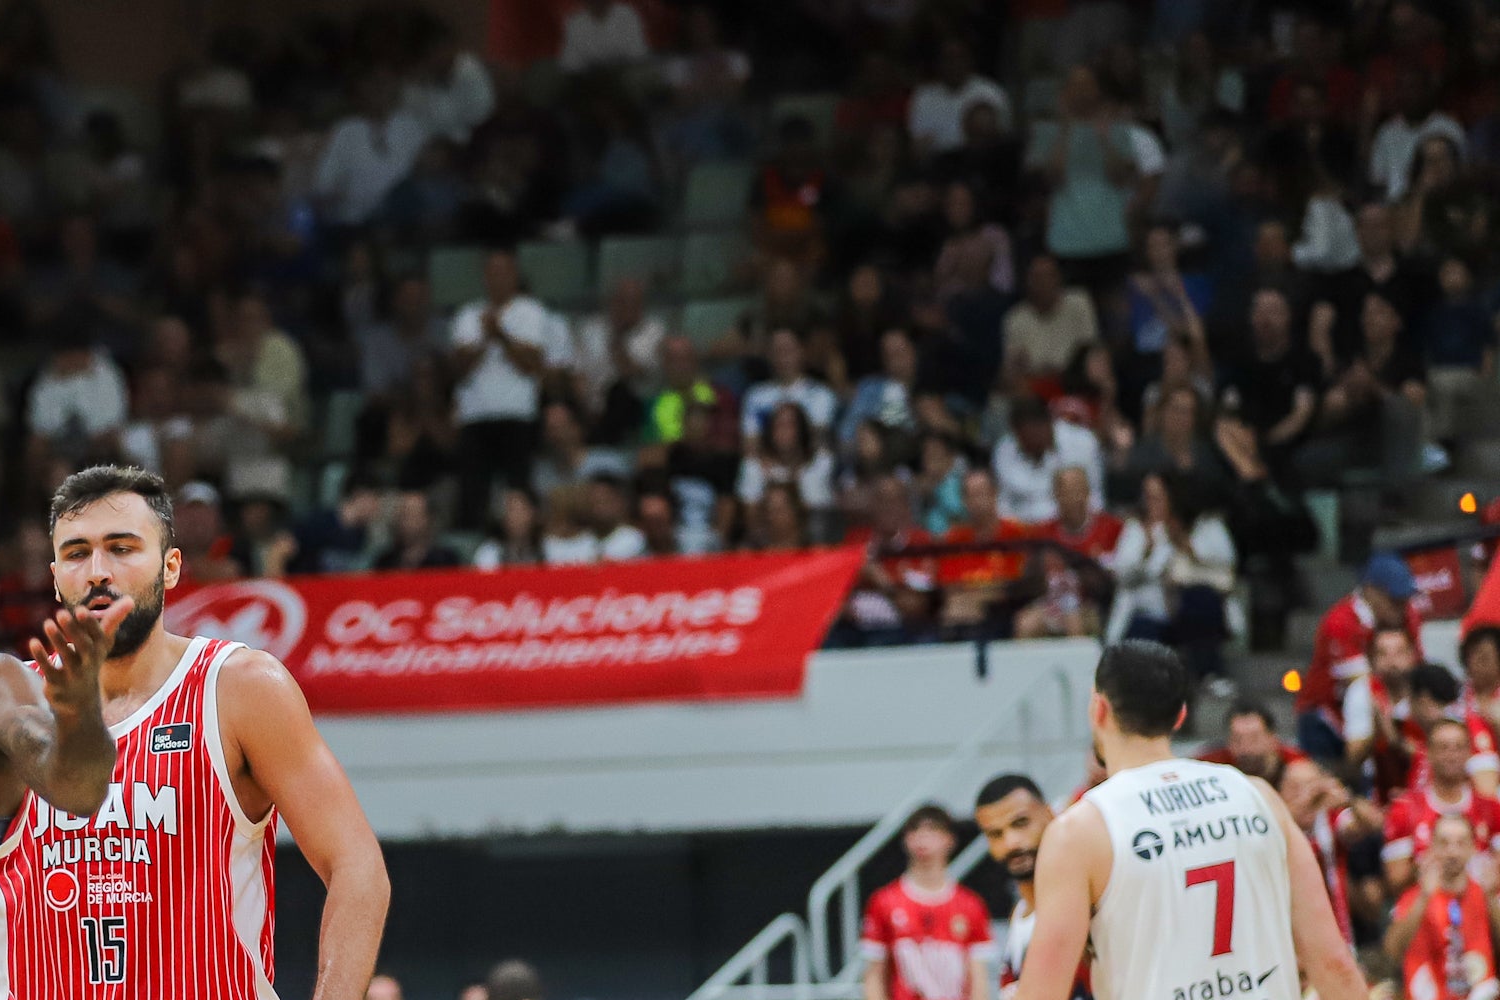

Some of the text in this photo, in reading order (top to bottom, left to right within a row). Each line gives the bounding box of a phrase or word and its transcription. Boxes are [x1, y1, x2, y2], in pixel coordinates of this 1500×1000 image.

[326, 586, 763, 645] OC Soluciones
[304, 629, 741, 677] Medioambientales
[154, 740, 188, 750] endesa
[1139, 777, 1229, 815] KURUCS
[1174, 815, 1269, 849] AMUTIO
[42, 836, 152, 871] MURCIA
[87, 880, 132, 893] REGIÓN
[87, 892, 154, 905] DE MURCIA
[1185, 860, 1236, 958] 7
[81, 916, 127, 984] 15
